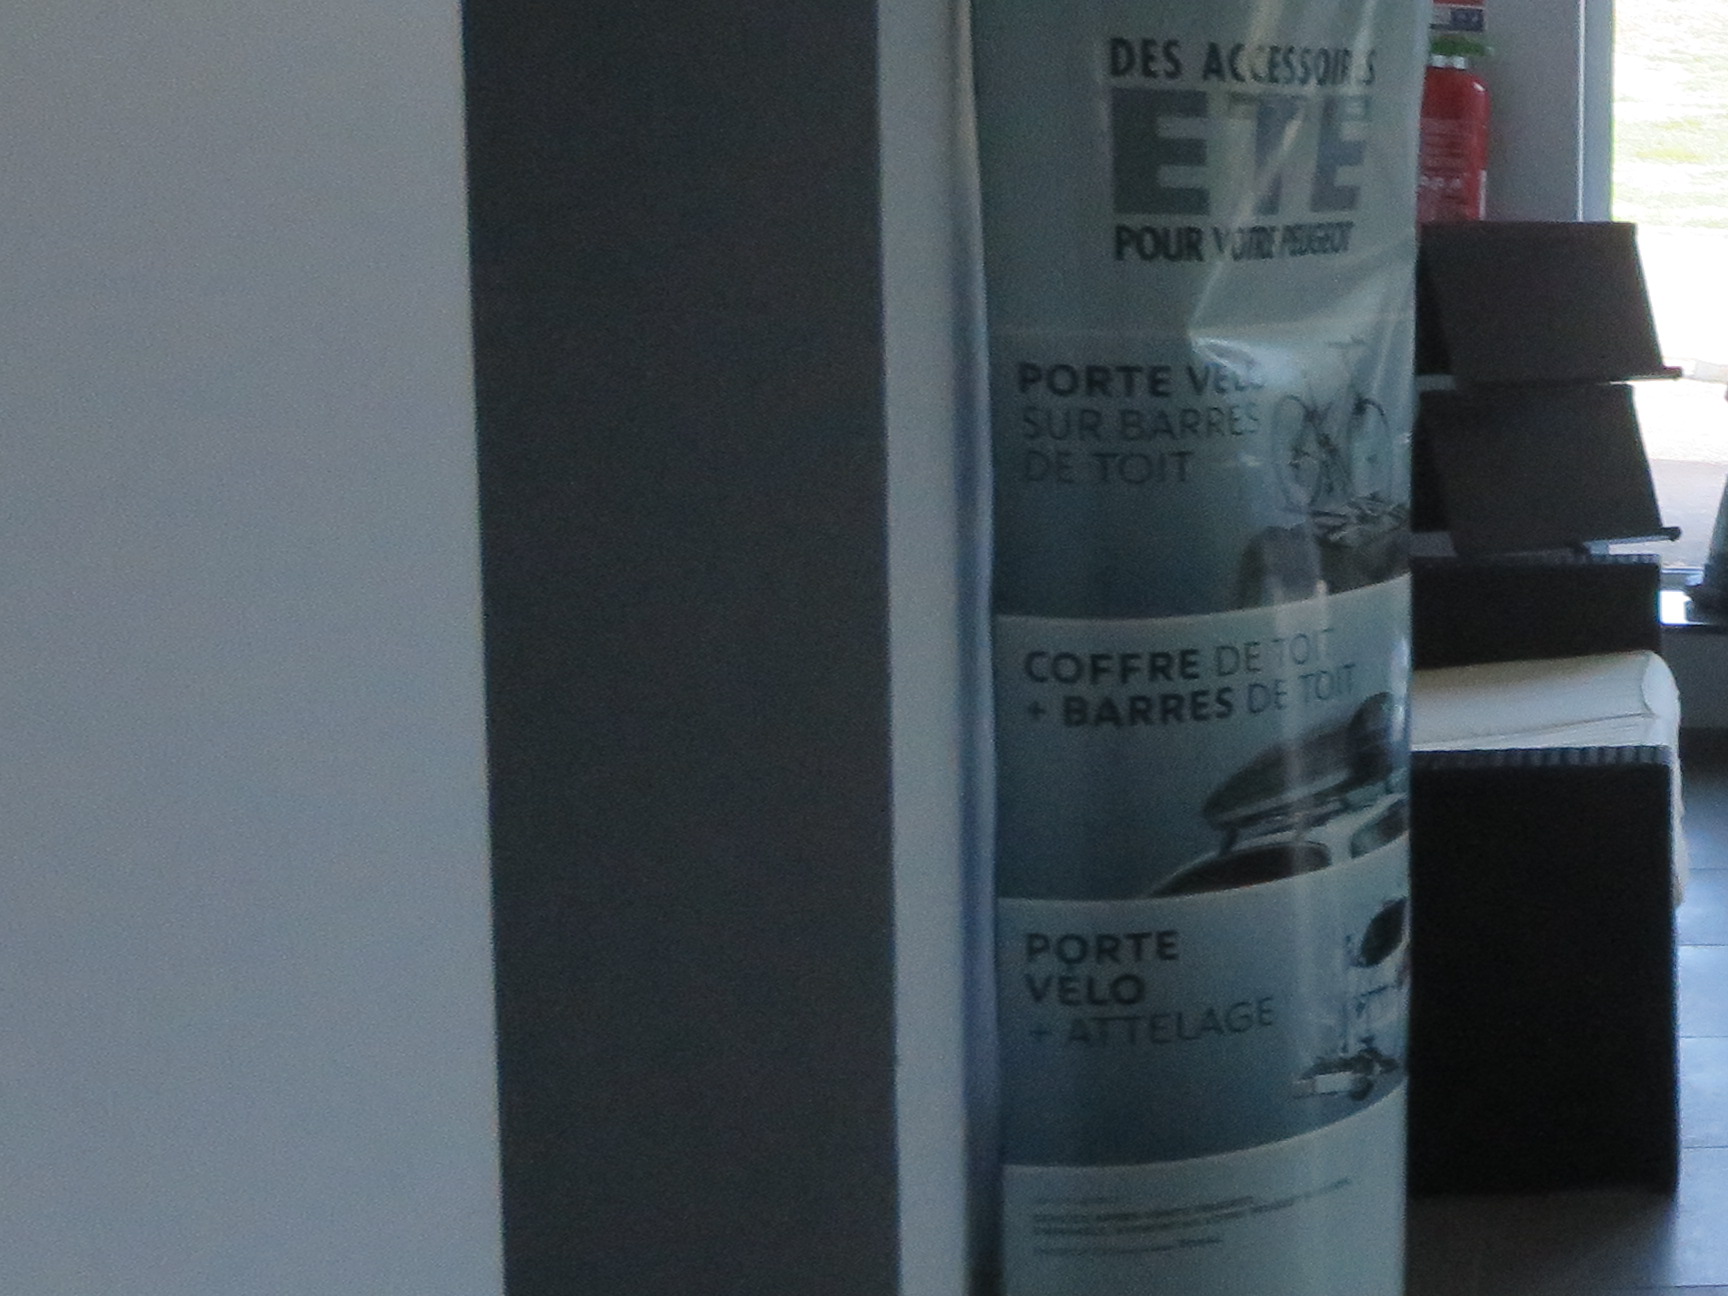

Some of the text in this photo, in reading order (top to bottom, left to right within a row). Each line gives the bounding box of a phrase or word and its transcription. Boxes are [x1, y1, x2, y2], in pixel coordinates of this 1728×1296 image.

[1109, 37, 1183, 80] DES
[1114, 223, 1205, 262] POUR
[1017, 361, 1173, 398] PORTE
[1022, 400, 1261, 441] SUR BARRES
[1024, 448, 1195, 485] DE TOIT
[1024, 647, 1201, 686] COFFRE
[1214, 640, 1262, 677] DE
[1063, 685, 1235, 729] BARRES
[1246, 678, 1288, 716] DE
[1298, 662, 1357, 702] TOIT
[1025, 929, 1181, 964] PORTE
[1025, 972, 1146, 1007] VELO
[1064, 994, 1275, 1048] ATTELAGE
